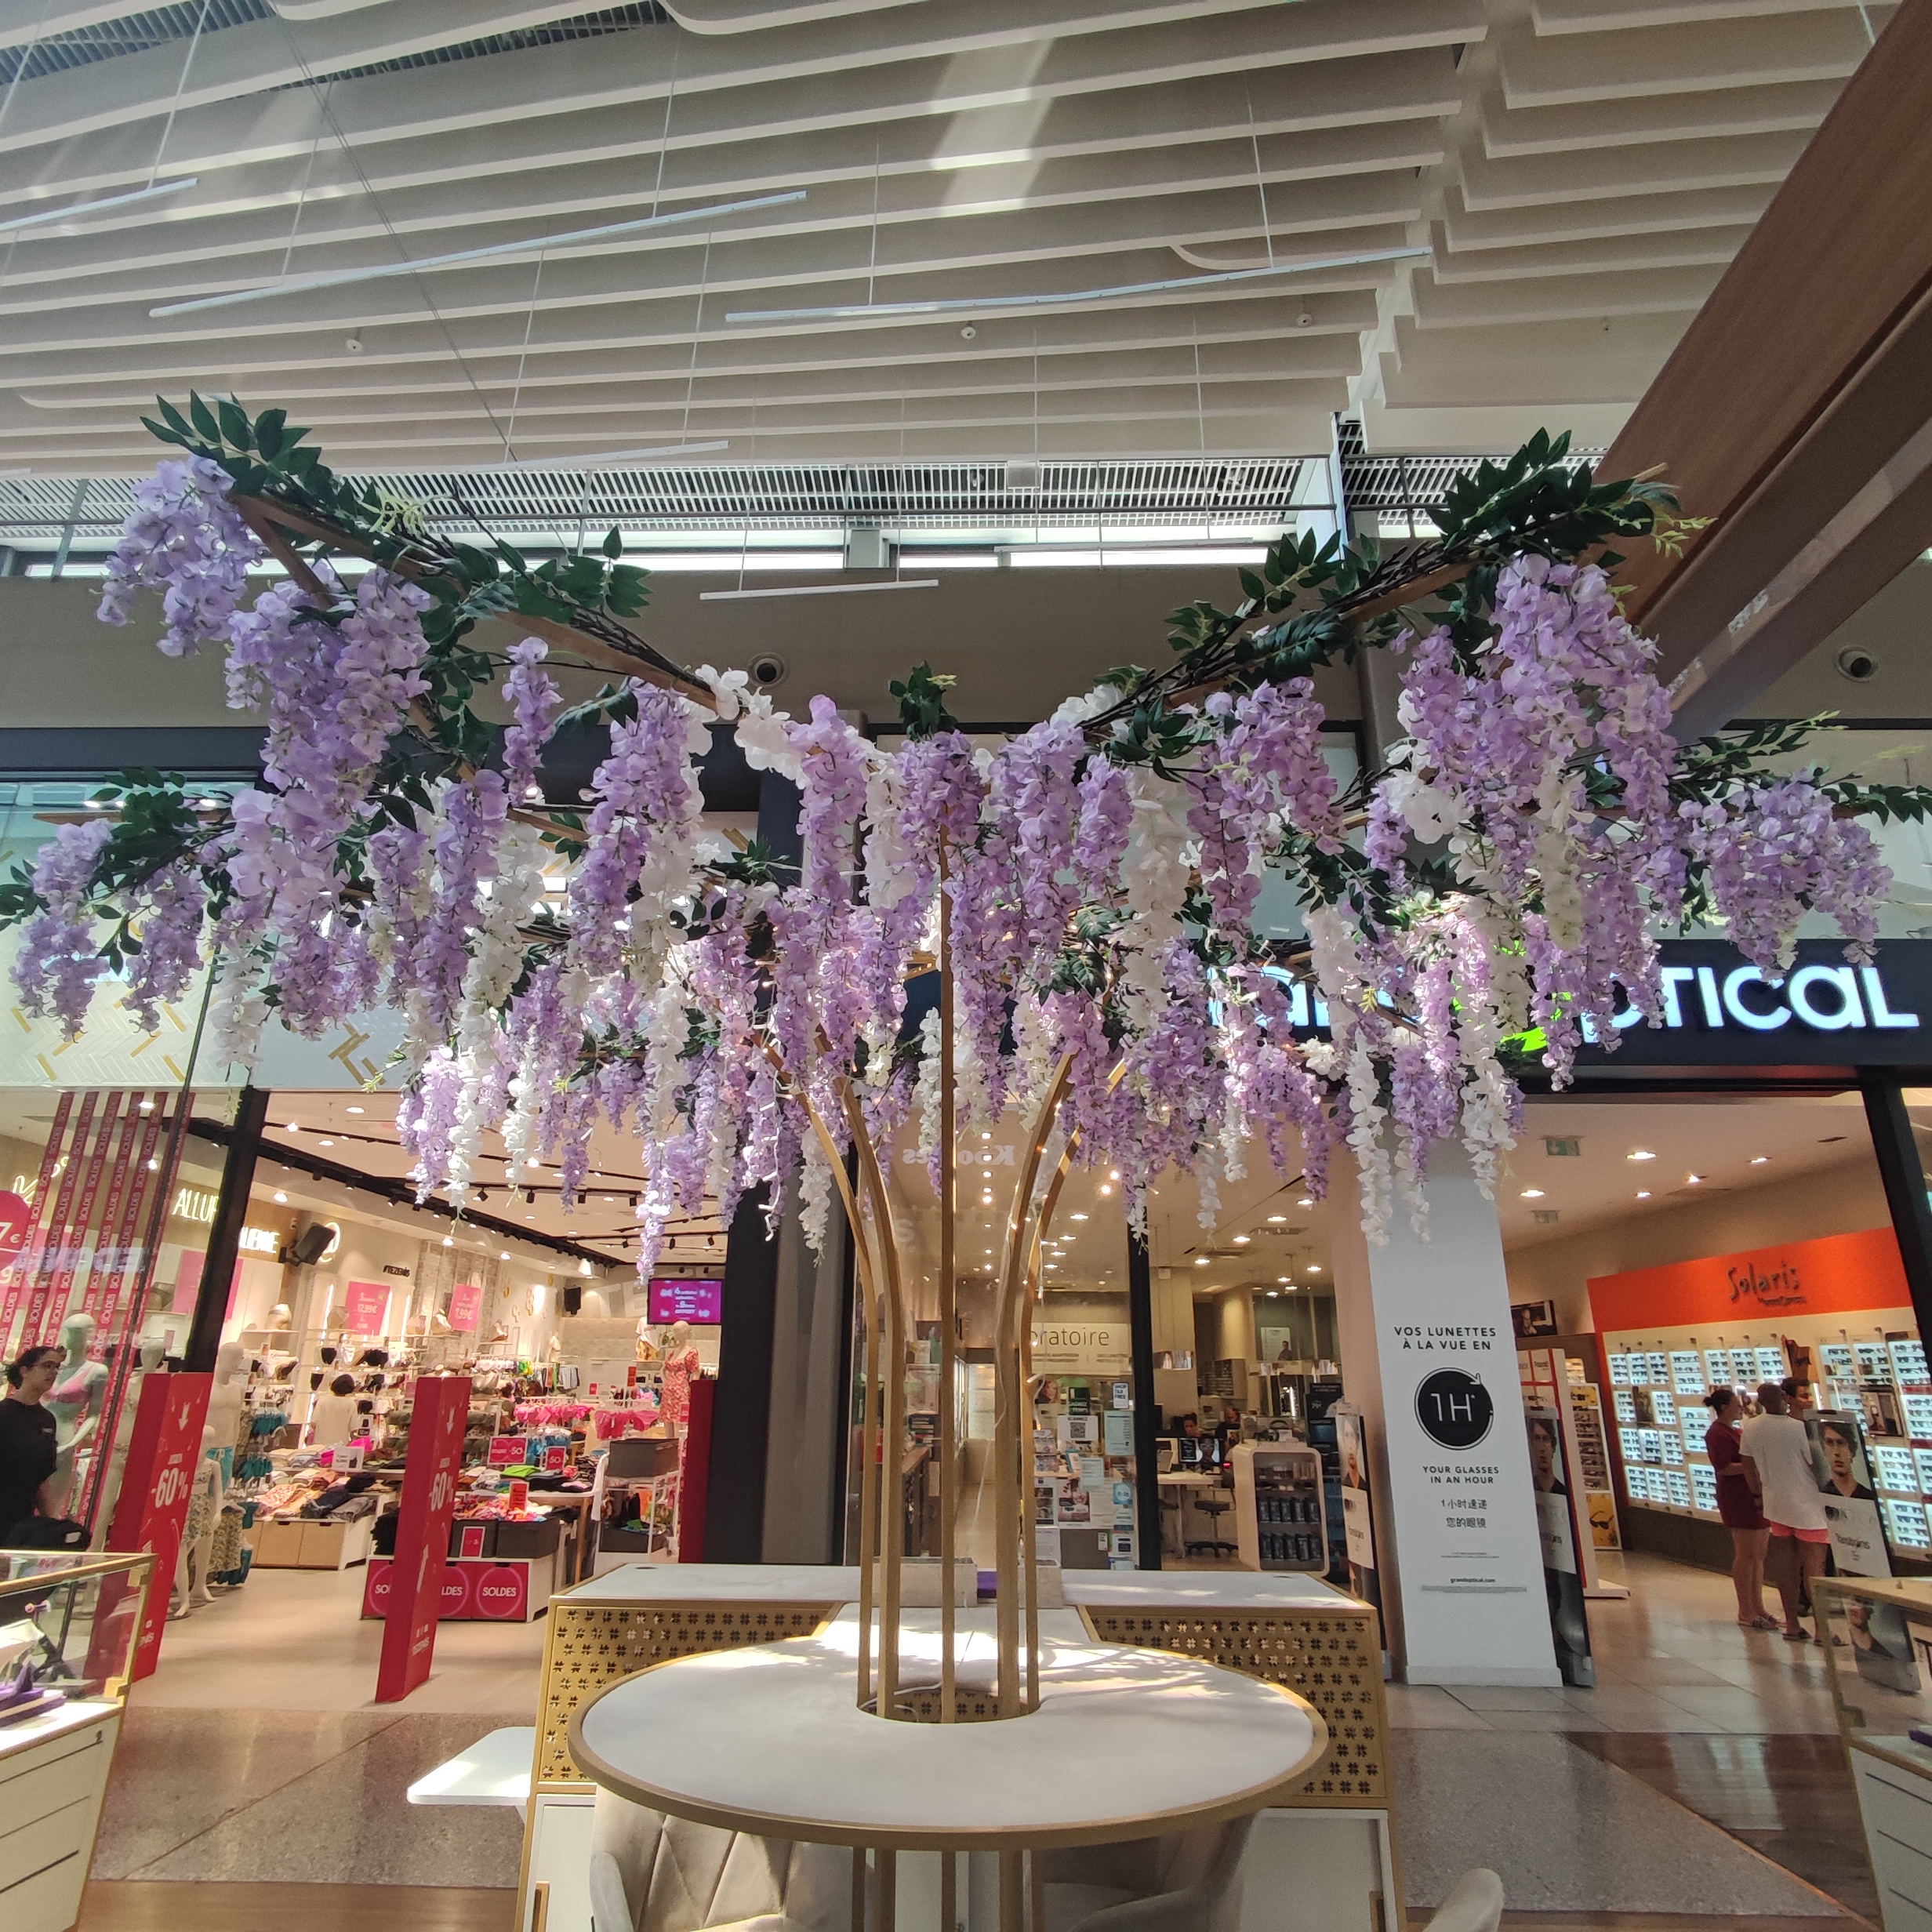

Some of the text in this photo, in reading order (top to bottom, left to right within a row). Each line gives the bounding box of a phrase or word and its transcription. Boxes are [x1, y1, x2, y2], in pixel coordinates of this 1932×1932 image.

[1727, 1259, 1799, 1303] Solaris
[1393, 1326, 1496, 1337] VOS LUNETTES
[1403, 1338, 1491, 1350] À LA VUE EN
[1422, 1465, 1451, 1474] YOUR
[151, 1468, 189, 1509] -60%
[429, 1472, 454, 1512] -60%
[482, 1586, 517, 1597] SOLDES
